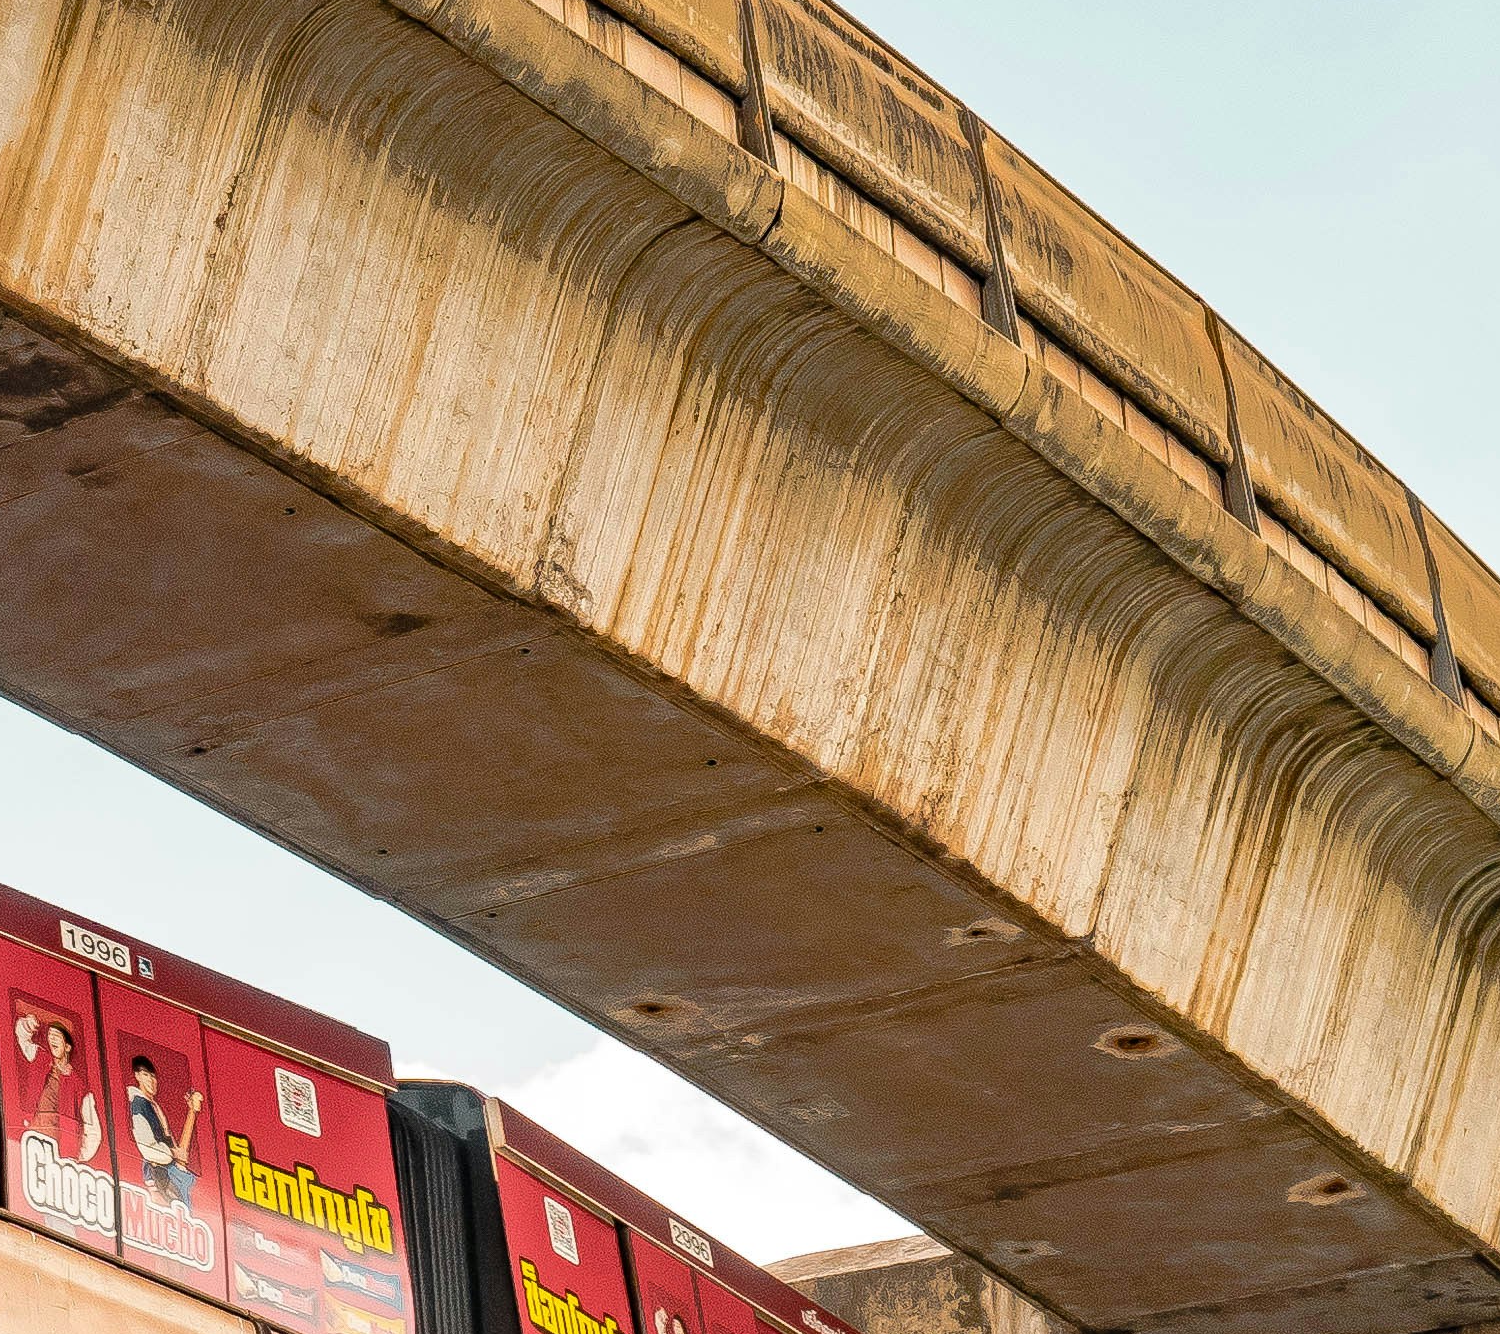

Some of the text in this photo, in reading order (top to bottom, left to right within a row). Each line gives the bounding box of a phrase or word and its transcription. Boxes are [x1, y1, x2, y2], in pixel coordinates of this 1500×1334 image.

[66, 929, 126, 967] 1996
[24, 1133, 212, 1268] Choco Mucho
[673, 1224, 710, 1261] 2996
